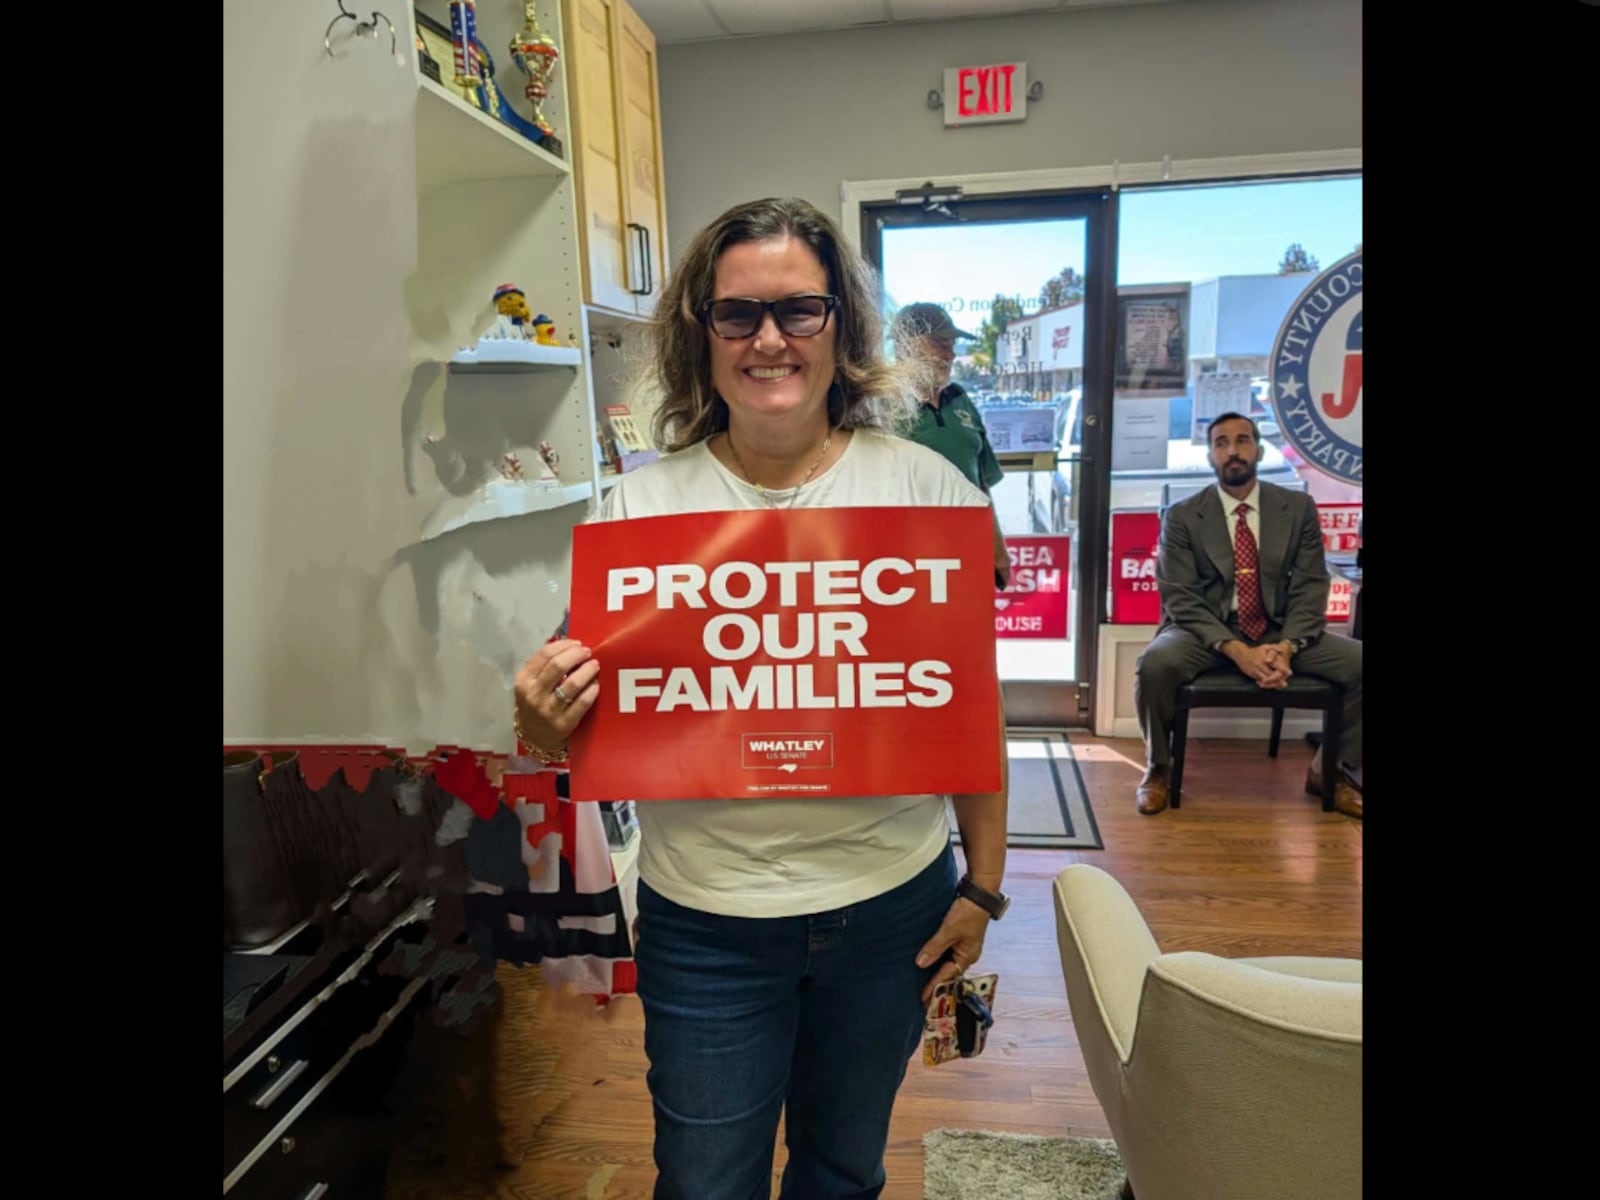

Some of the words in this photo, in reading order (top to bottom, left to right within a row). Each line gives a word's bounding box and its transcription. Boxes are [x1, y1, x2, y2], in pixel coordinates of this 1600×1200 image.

[958, 64, 1017, 117] EXIT
[606, 557, 962, 612] PROTECT
[702, 611, 869, 661] OUR
[994, 616, 1042, 632] OUSE
[616, 660, 954, 714] FAMILIES
[748, 740, 825, 752] WHATLEY
